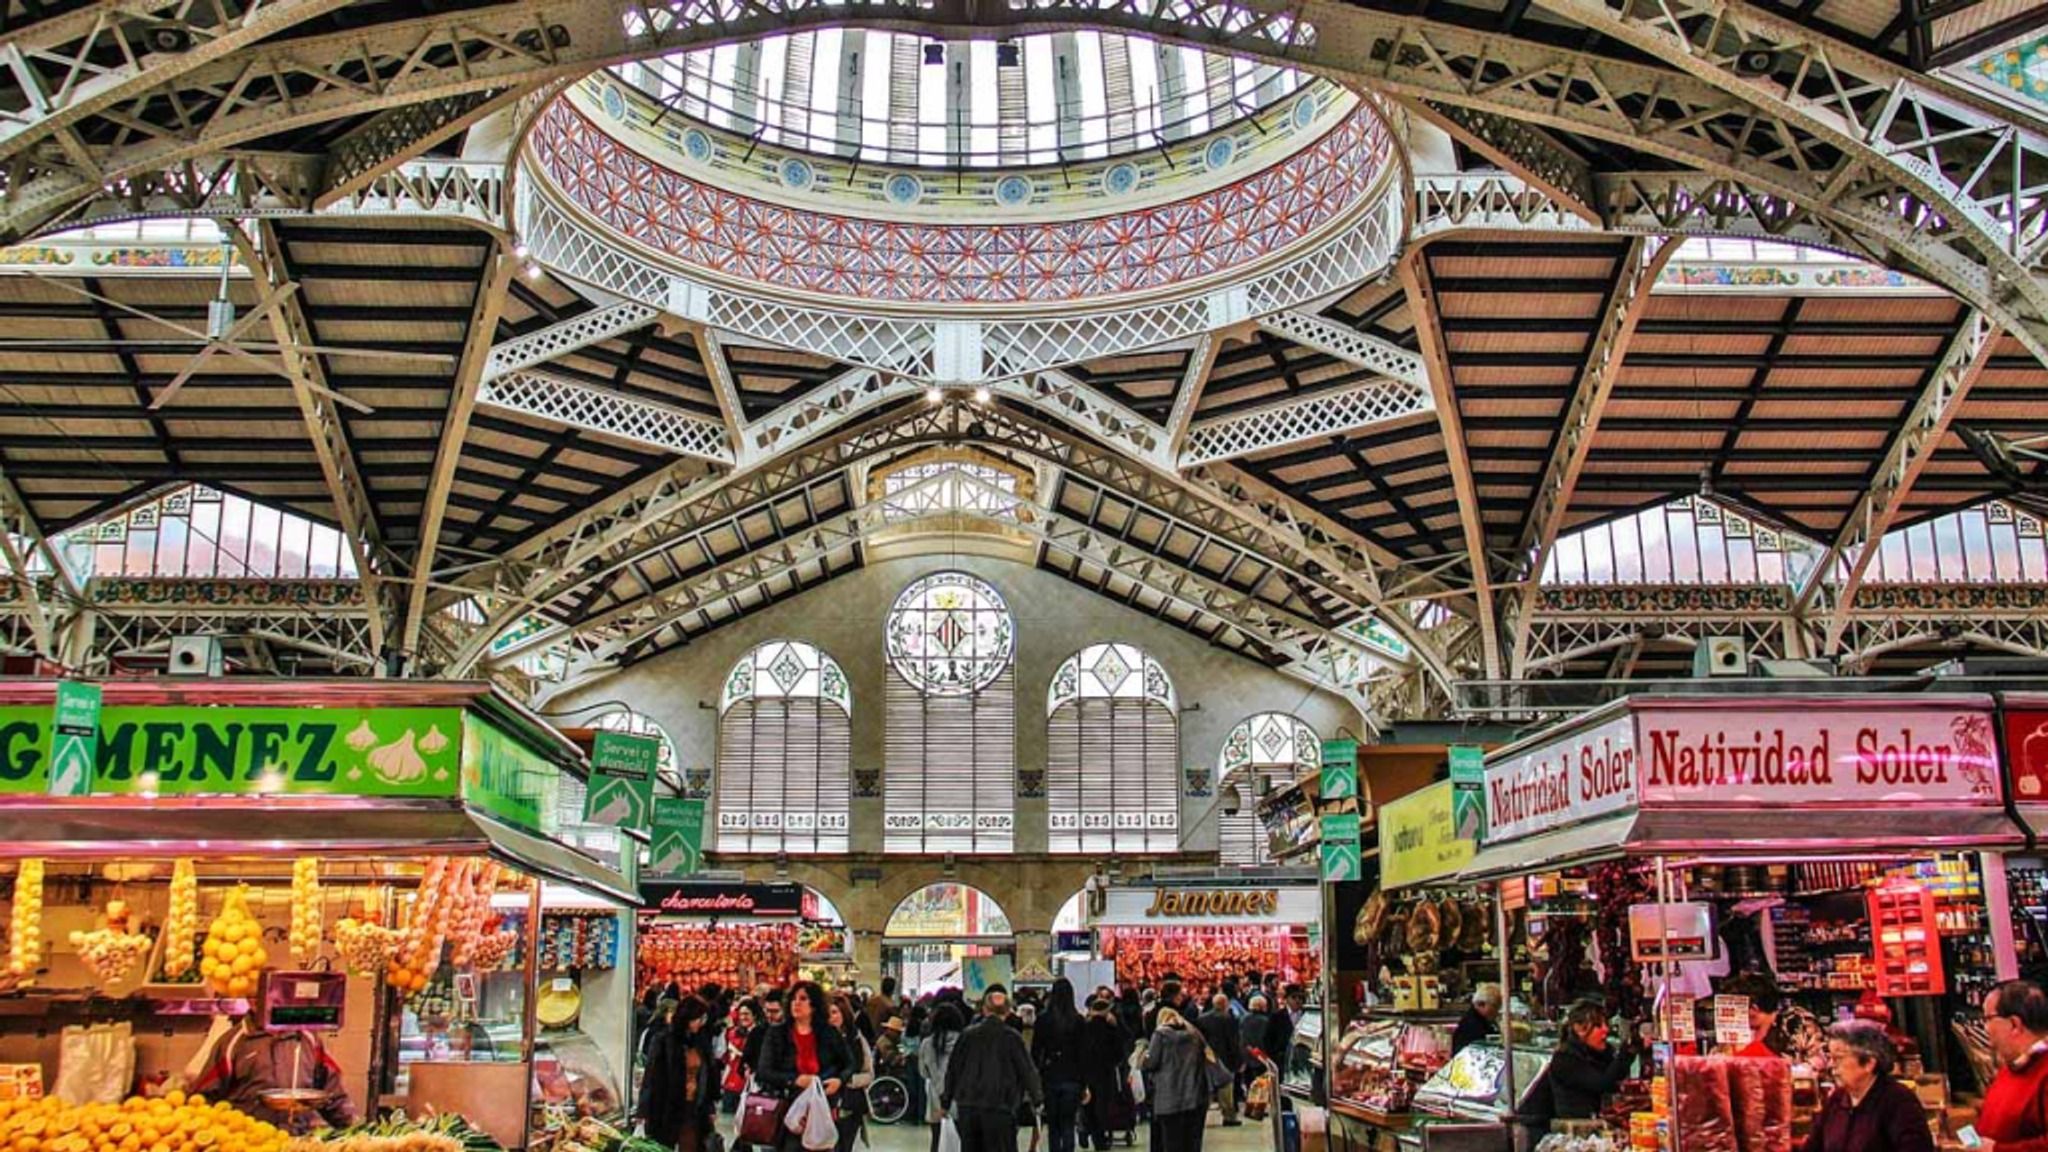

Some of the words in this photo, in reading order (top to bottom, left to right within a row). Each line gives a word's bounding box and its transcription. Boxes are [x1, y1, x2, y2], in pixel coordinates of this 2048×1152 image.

[0, 721, 337, 781] GMENEZ
[602, 741, 640, 757] Servei
[1648, 729, 1832, 786] Natividad
[1856, 727, 1952, 785] Soler
[1491, 754, 1570, 828] Natividad
[1580, 738, 1633, 801] Soler
[1145, 887, 1279, 917] Jamones
